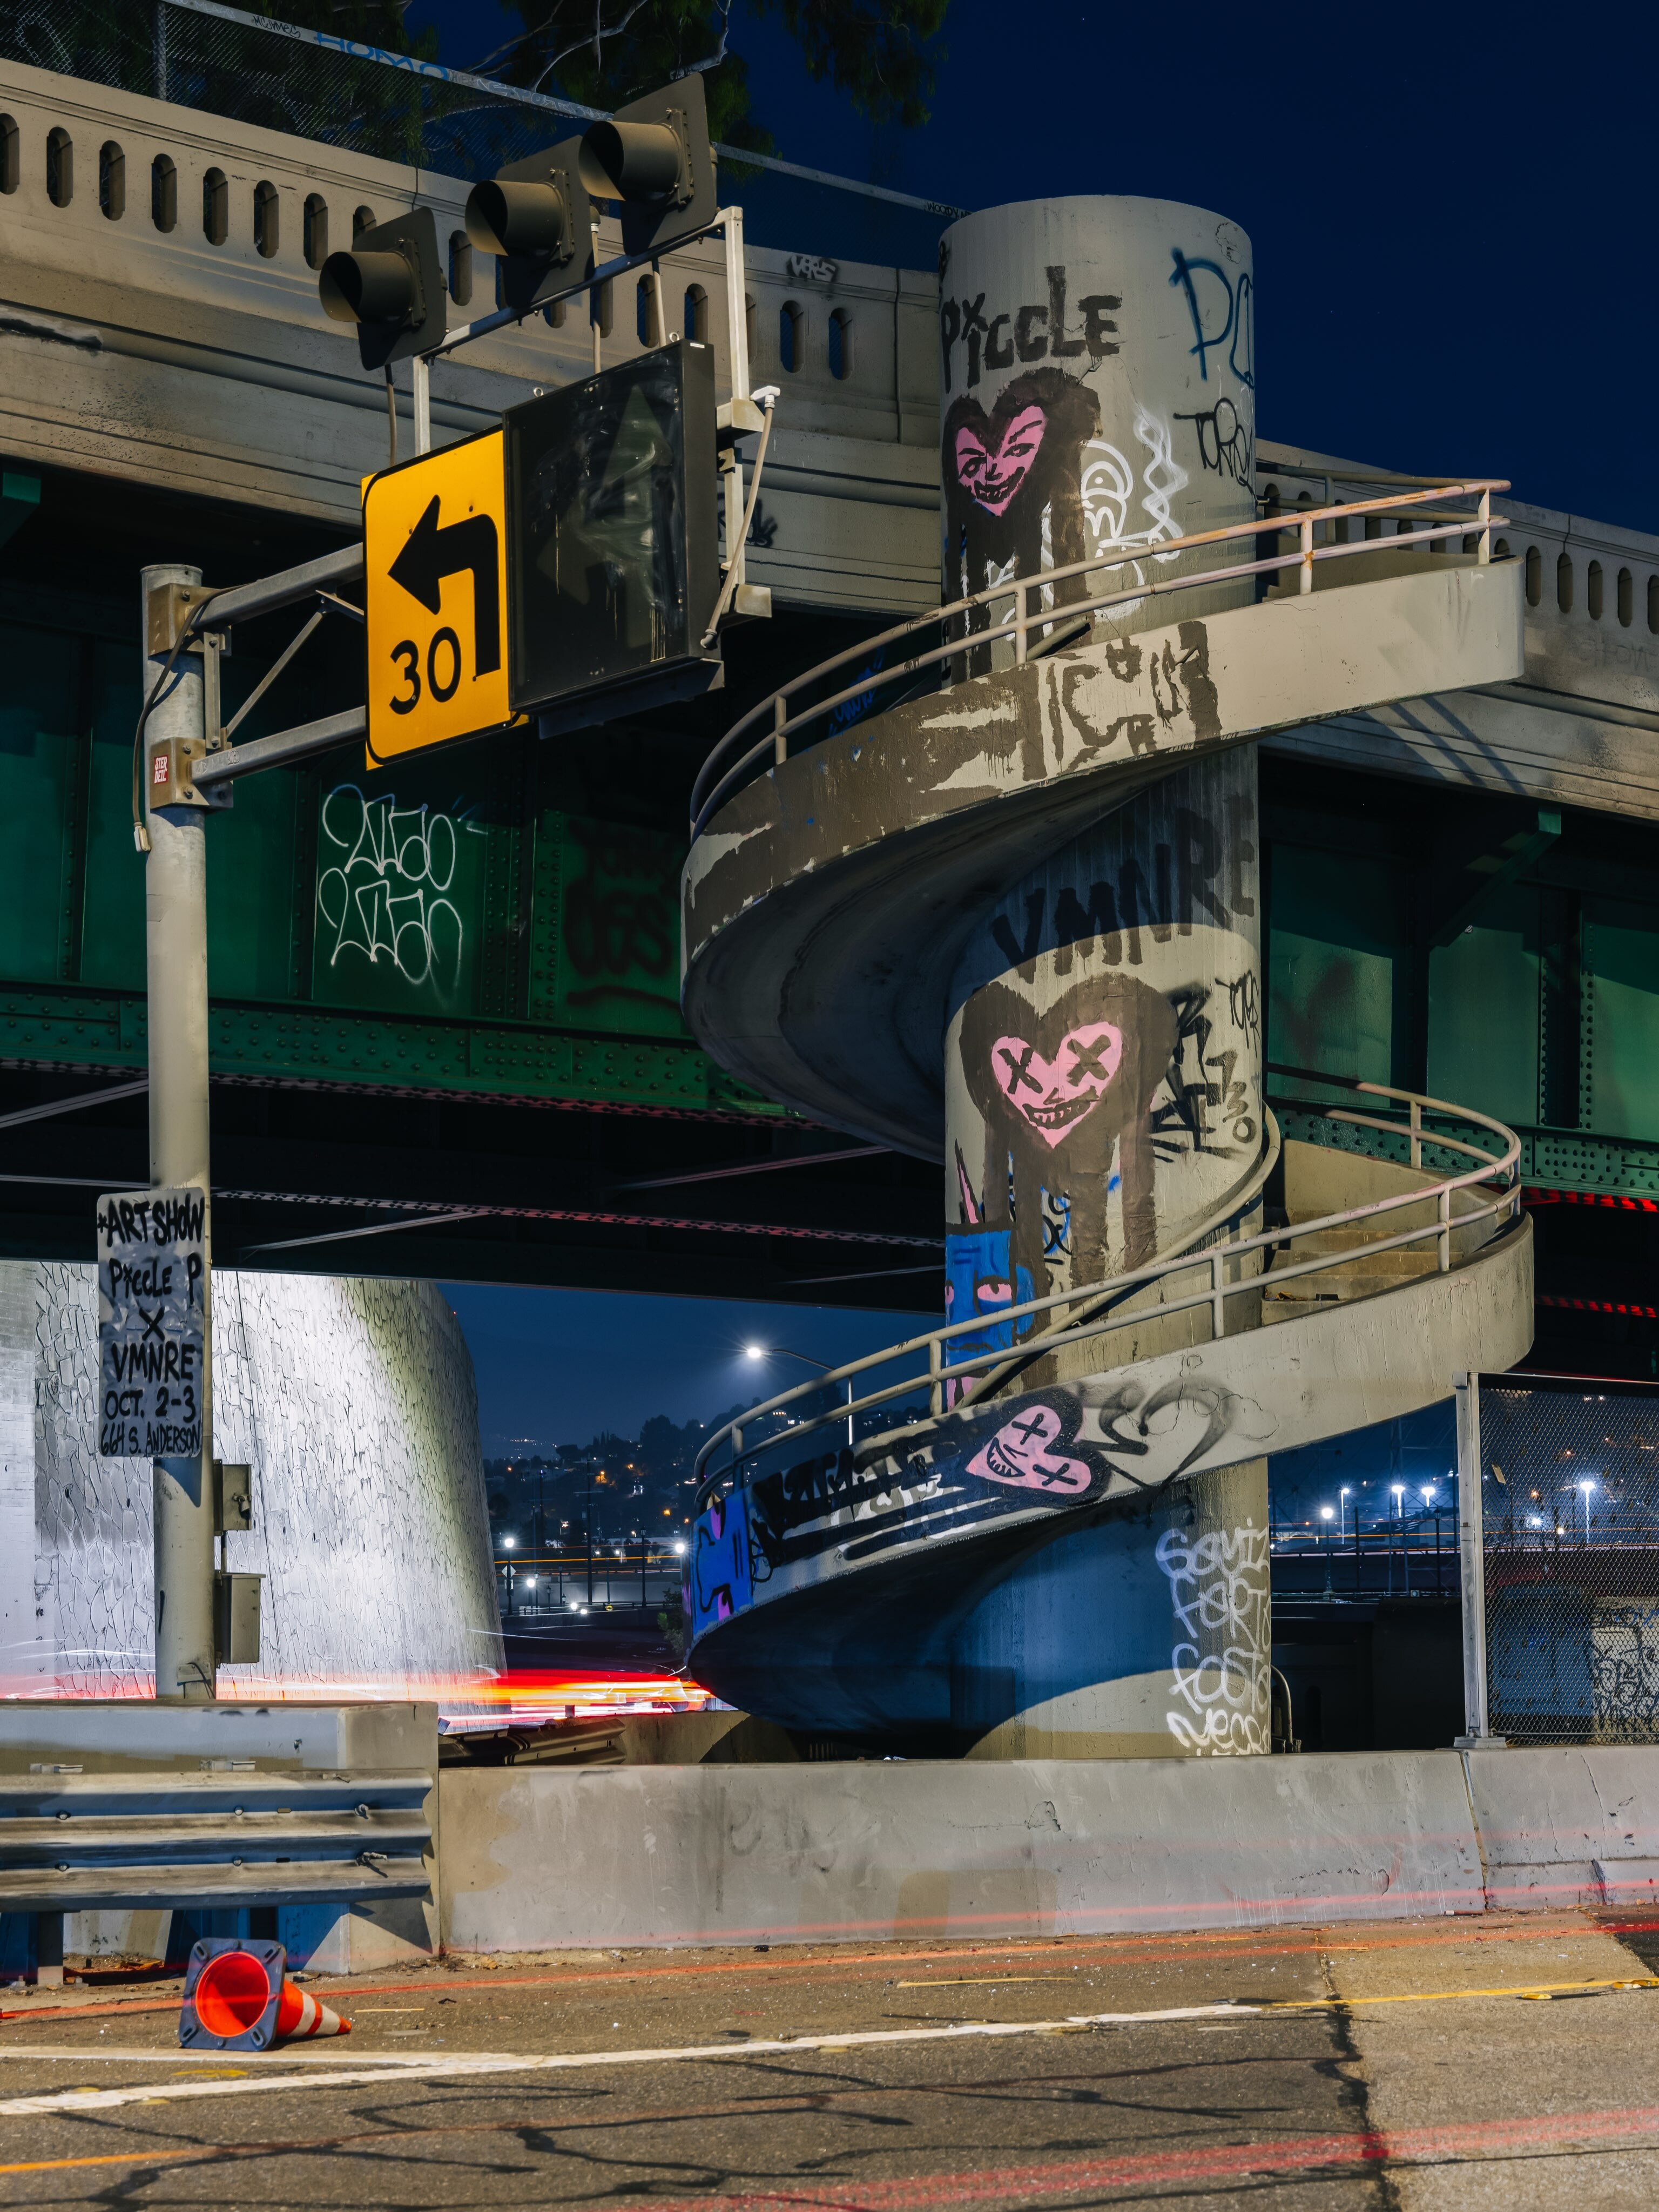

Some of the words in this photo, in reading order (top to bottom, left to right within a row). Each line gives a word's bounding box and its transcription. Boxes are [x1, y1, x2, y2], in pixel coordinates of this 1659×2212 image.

[389, 625, 462, 716] 30
[152, 1193, 205, 1246] SHOW
[187, 1252, 202, 1305] P
[139, 1306, 165, 1342] X
[111, 1340, 196, 1384] VMNRE
[105, 1388, 145, 1420] OCT.
[156, 1385, 196, 1423] 2-3
[101, 1421, 125, 1456] 664
[129, 1426, 141, 1454] S.
[146, 1420, 201, 1455] ANDERSON
